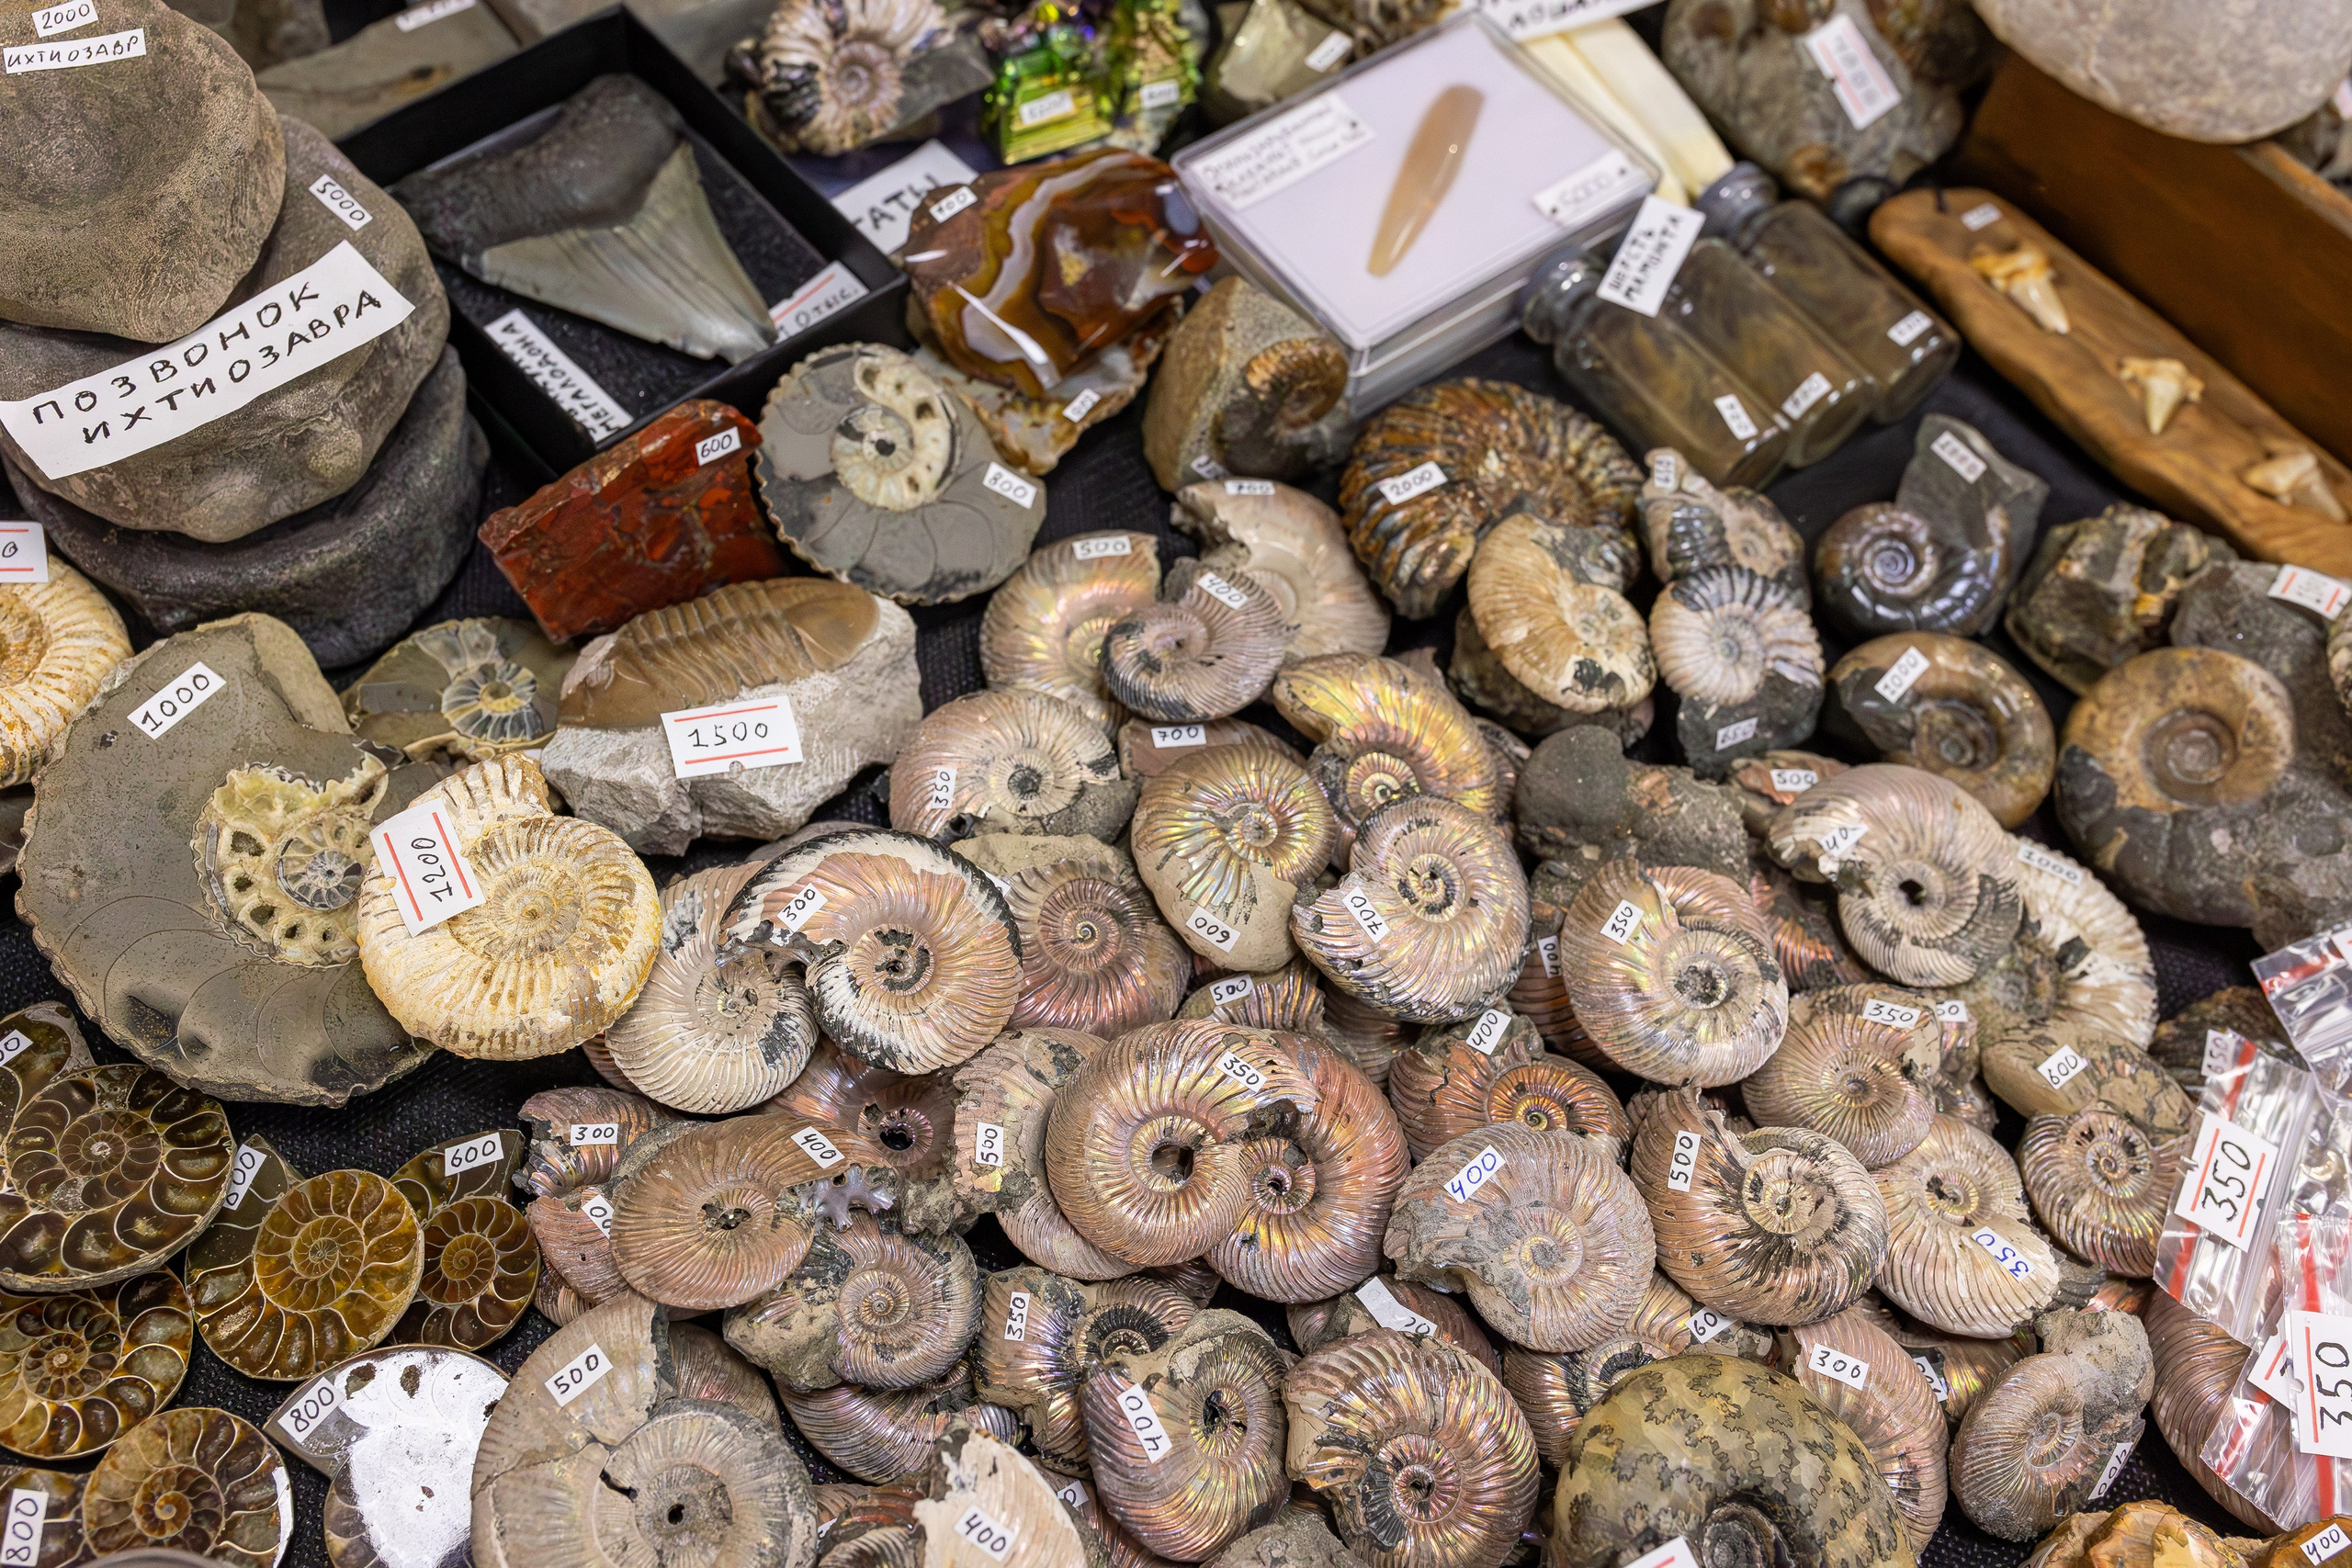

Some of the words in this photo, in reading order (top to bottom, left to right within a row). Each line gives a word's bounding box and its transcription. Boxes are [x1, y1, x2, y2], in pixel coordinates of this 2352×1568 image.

[42, 4, 90, 30] 2000
[7, 36, 139, 68] ИХТИОЗАВР
[317, 181, 366, 222] 5000
[32, 281, 320, 425] ПОЗВОНОК
[83, 290, 381, 444] ИХТИОЗАВРА
[701, 434, 733, 457] 600
[989, 469, 1028, 500] 800
[1389, 469, 1432, 497] 2000
[1080, 540, 1126, 557] 500
[1209, 576, 1244, 604] 400
[141, 672, 210, 733] 1000
[687, 721, 769, 750] 1500
[1158, 725, 1199, 742] 700
[934, 771, 951, 806] 350
[1777, 773, 1815, 785] 500
[410, 837, 453, 903] 1200
[2024, 847, 2081, 880] 1000
[782, 887, 816, 921] 300
[1351, 897, 1382, 935] 700
[1195, 917, 1230, 943] 600
[1610, 906, 1634, 939] 350
[1544, 942, 1560, 976] 400
[1214, 979, 1247, 1001] 500
[1872, 1002, 1914, 1023] 350
[1472, 1013, 1498, 1047] 400
[1223, 1056, 1260, 1086] 350
[2049, 1055, 2079, 1086] 600
[574, 1125, 615, 1142] 300
[802, 1132, 837, 1161] 400
[980, 1128, 999, 1164] 500
[450, 1139, 497, 1168] 600
[1670, 1136, 1694, 1184] 500
[1451, 1152, 1498, 1199] 400
[2200, 1140, 2252, 1223] 350
[1975, 1232, 2030, 1279] 350
[1007, 1297, 1026, 1339] 350
[554, 1353, 600, 1394] 500
[1816, 1349, 1861, 1379] 300
[2315, 1341, 2351, 1440] 350
[288, 1386, 335, 1431] 800
[1124, 1394, 1161, 1452] 400
[5, 1497, 39, 1565] 800
[966, 1513, 1006, 1553] 400
[2306, 1527, 2342, 1562] 400
